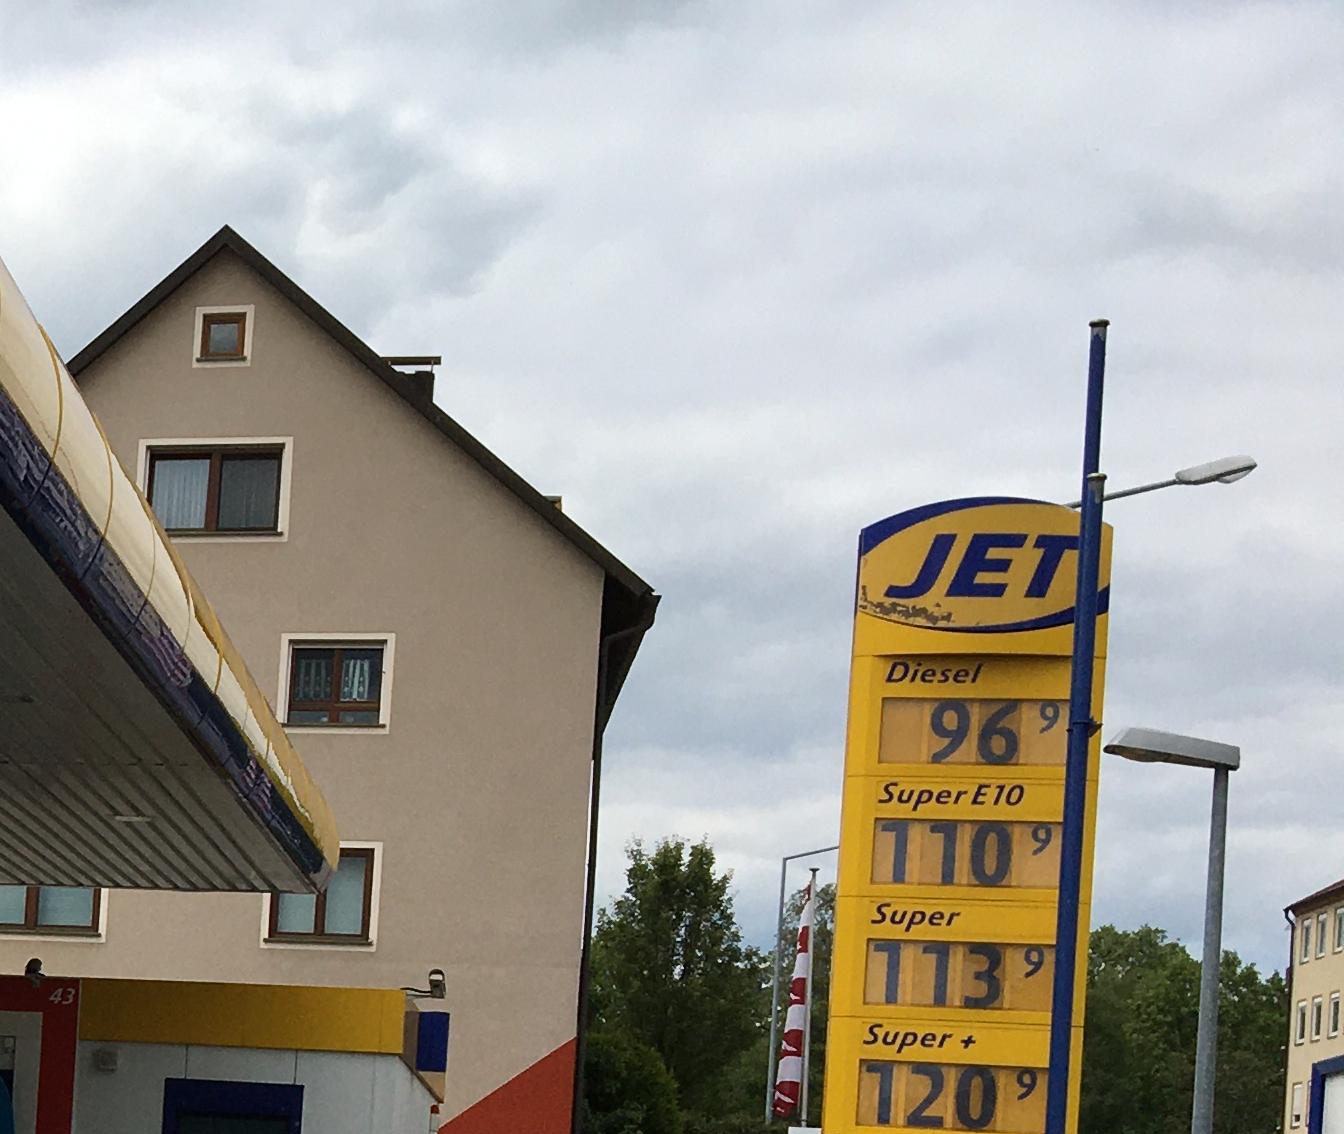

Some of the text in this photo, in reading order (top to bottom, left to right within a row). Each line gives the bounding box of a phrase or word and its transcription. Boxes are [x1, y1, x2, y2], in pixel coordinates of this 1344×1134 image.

[884, 534, 1078, 598] JET
[885, 661, 982, 684] Diesel
[878, 782, 1025, 812] Super E10
[870, 902, 961, 932] Super
[48, 987, 76, 1006] 43
[862, 1023, 953, 1053] Super
